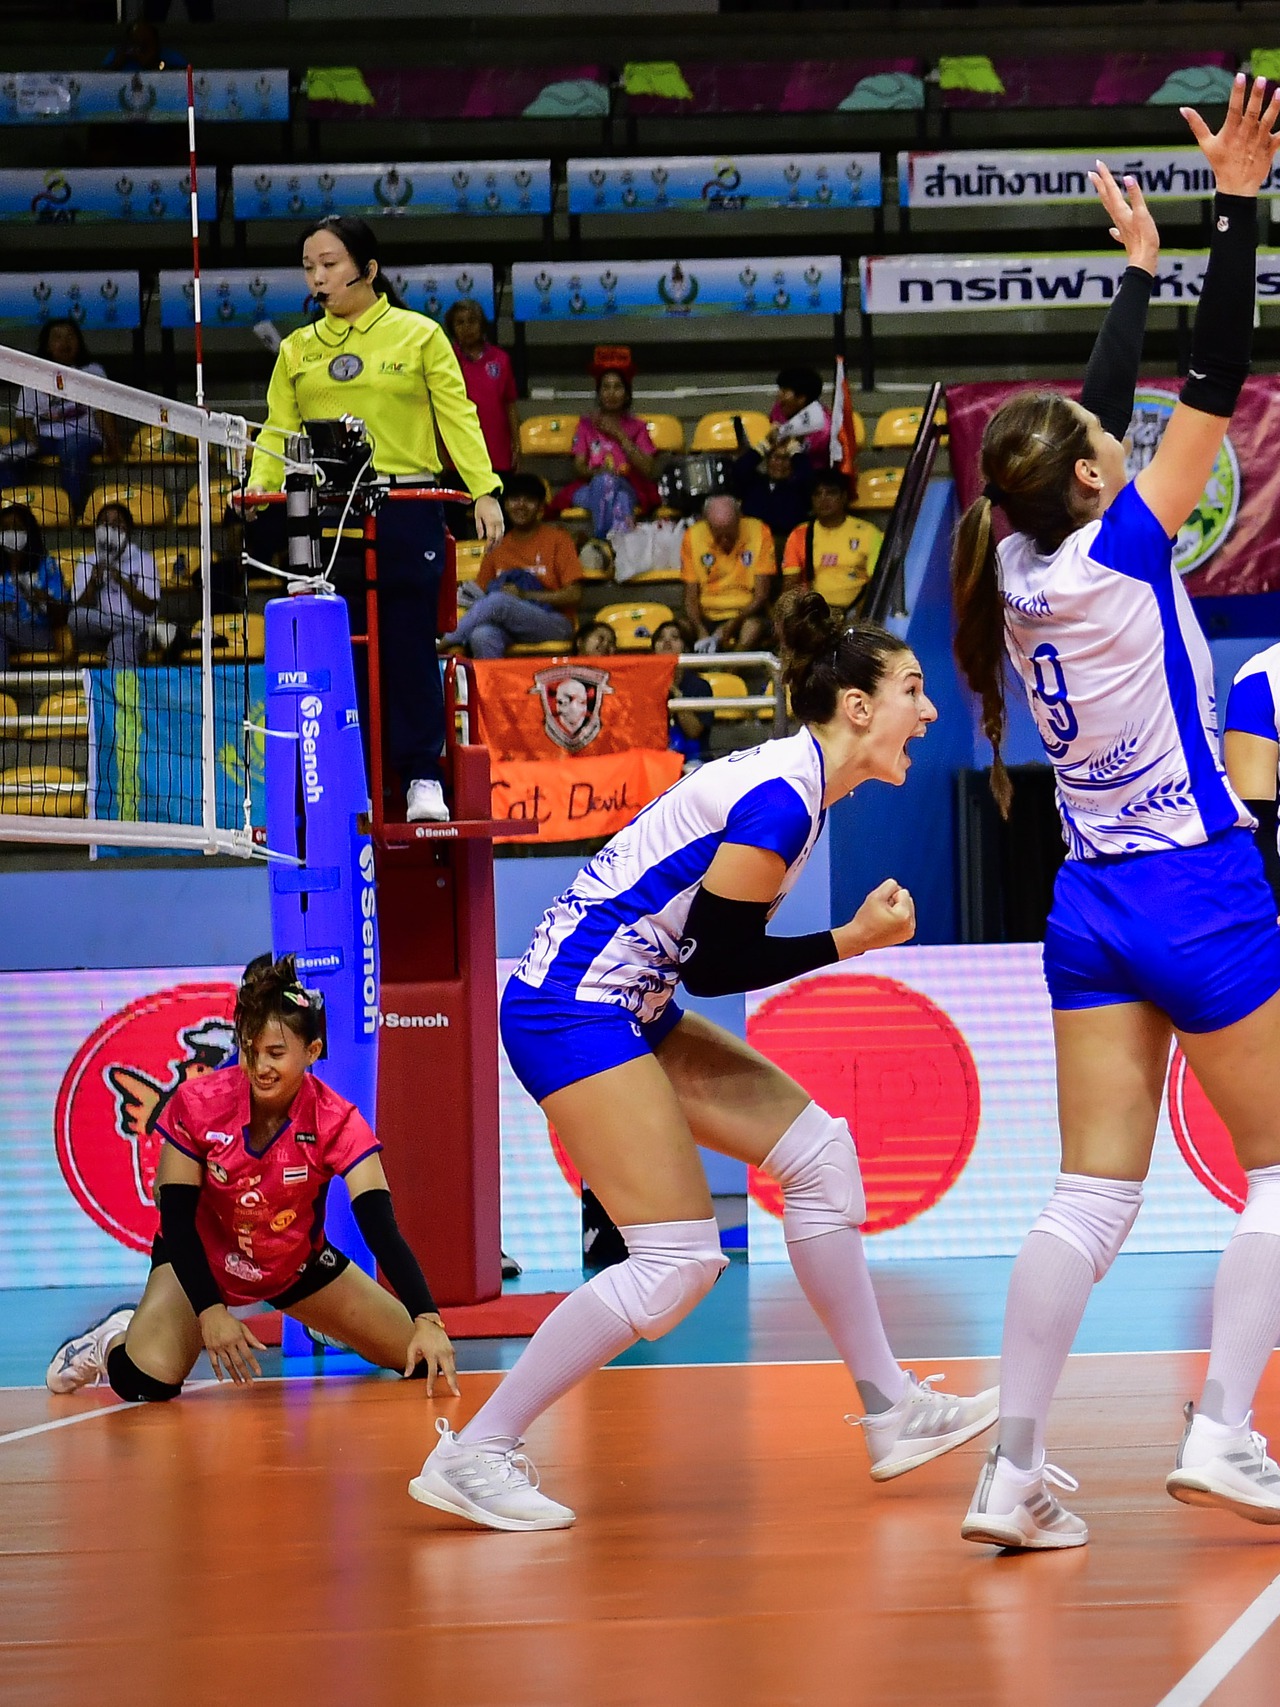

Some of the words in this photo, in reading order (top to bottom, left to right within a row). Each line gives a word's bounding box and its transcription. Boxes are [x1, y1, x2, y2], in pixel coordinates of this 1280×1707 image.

[302, 719, 324, 804] Senoh
[295, 954, 340, 969] Senoh
[361, 886, 379, 1035] Senoh
[385, 1012, 449, 1029] Senoh
